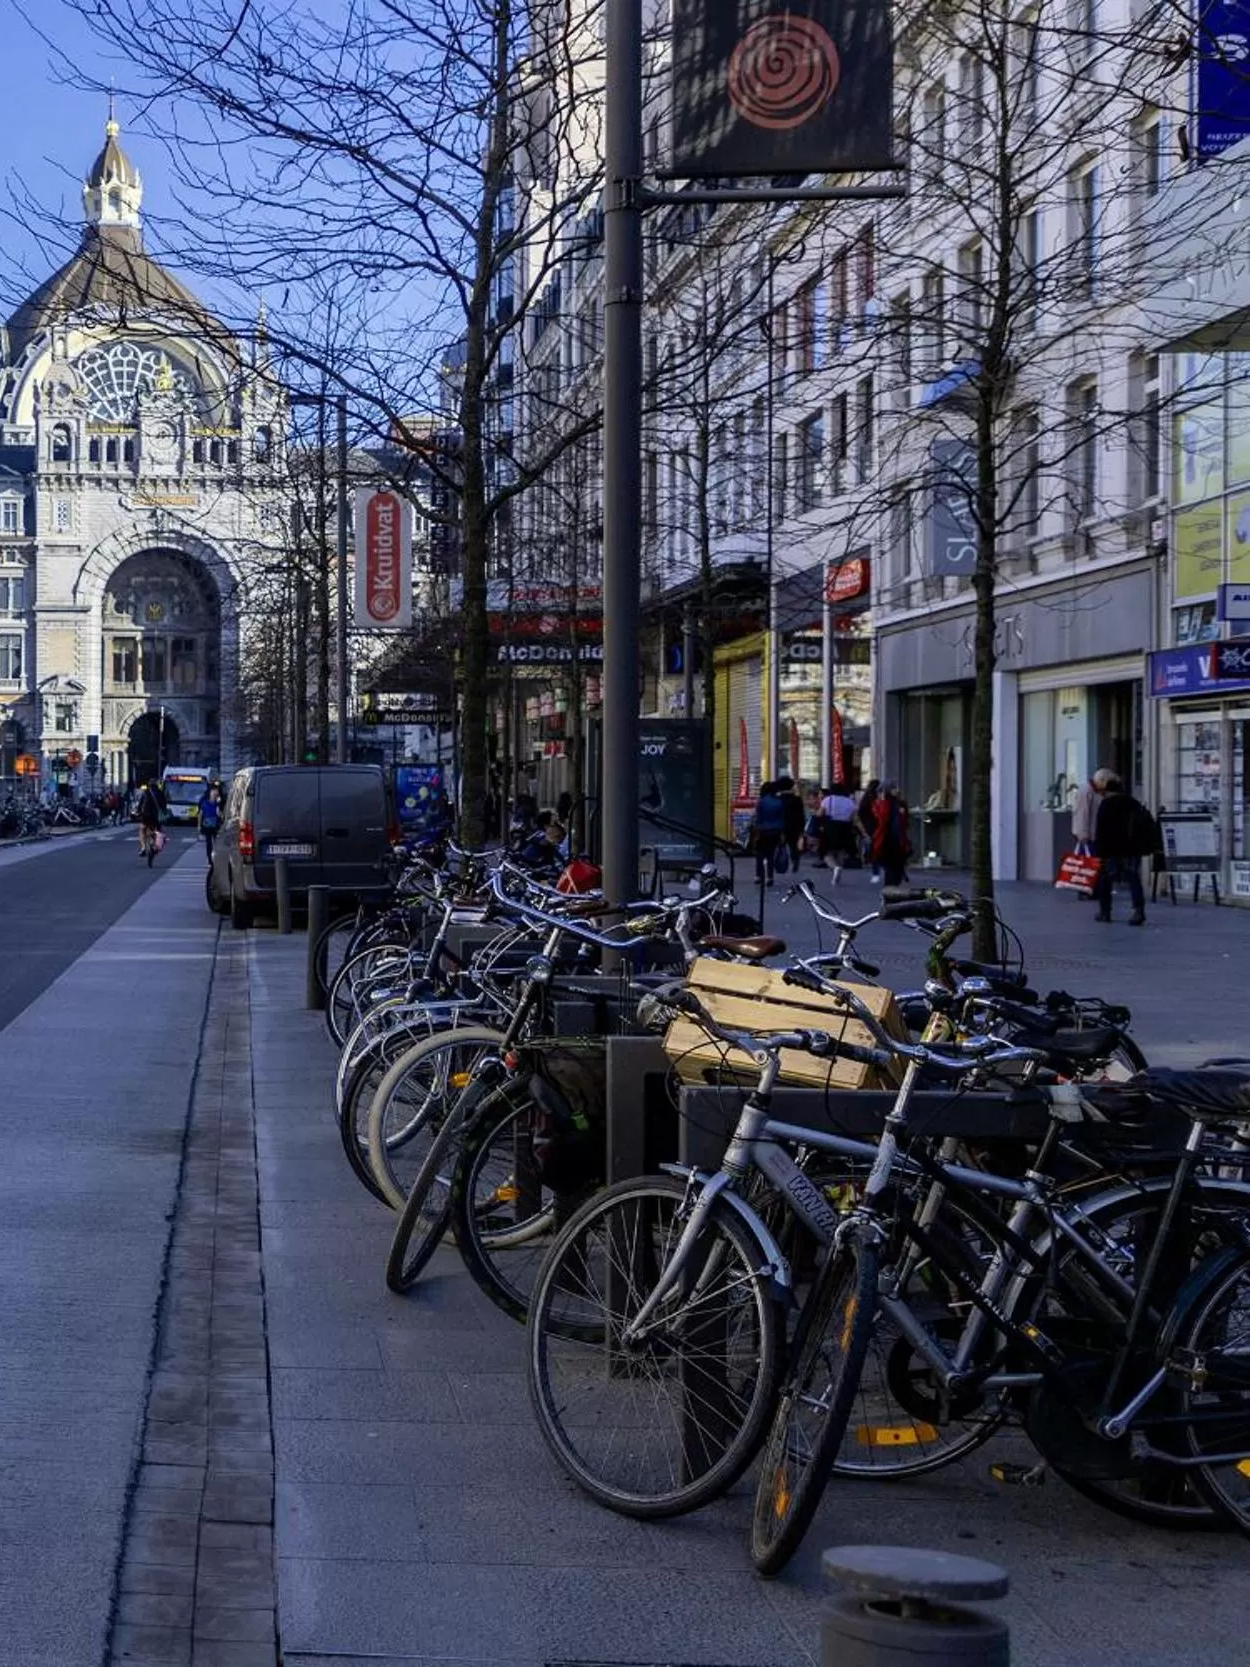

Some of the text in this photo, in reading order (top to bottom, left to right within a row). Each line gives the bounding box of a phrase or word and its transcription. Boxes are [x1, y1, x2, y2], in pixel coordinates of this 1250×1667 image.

[374, 503, 394, 590] Kruidvat
[640, 743, 666, 756] JOY
[788, 1174, 823, 1213] VAN
